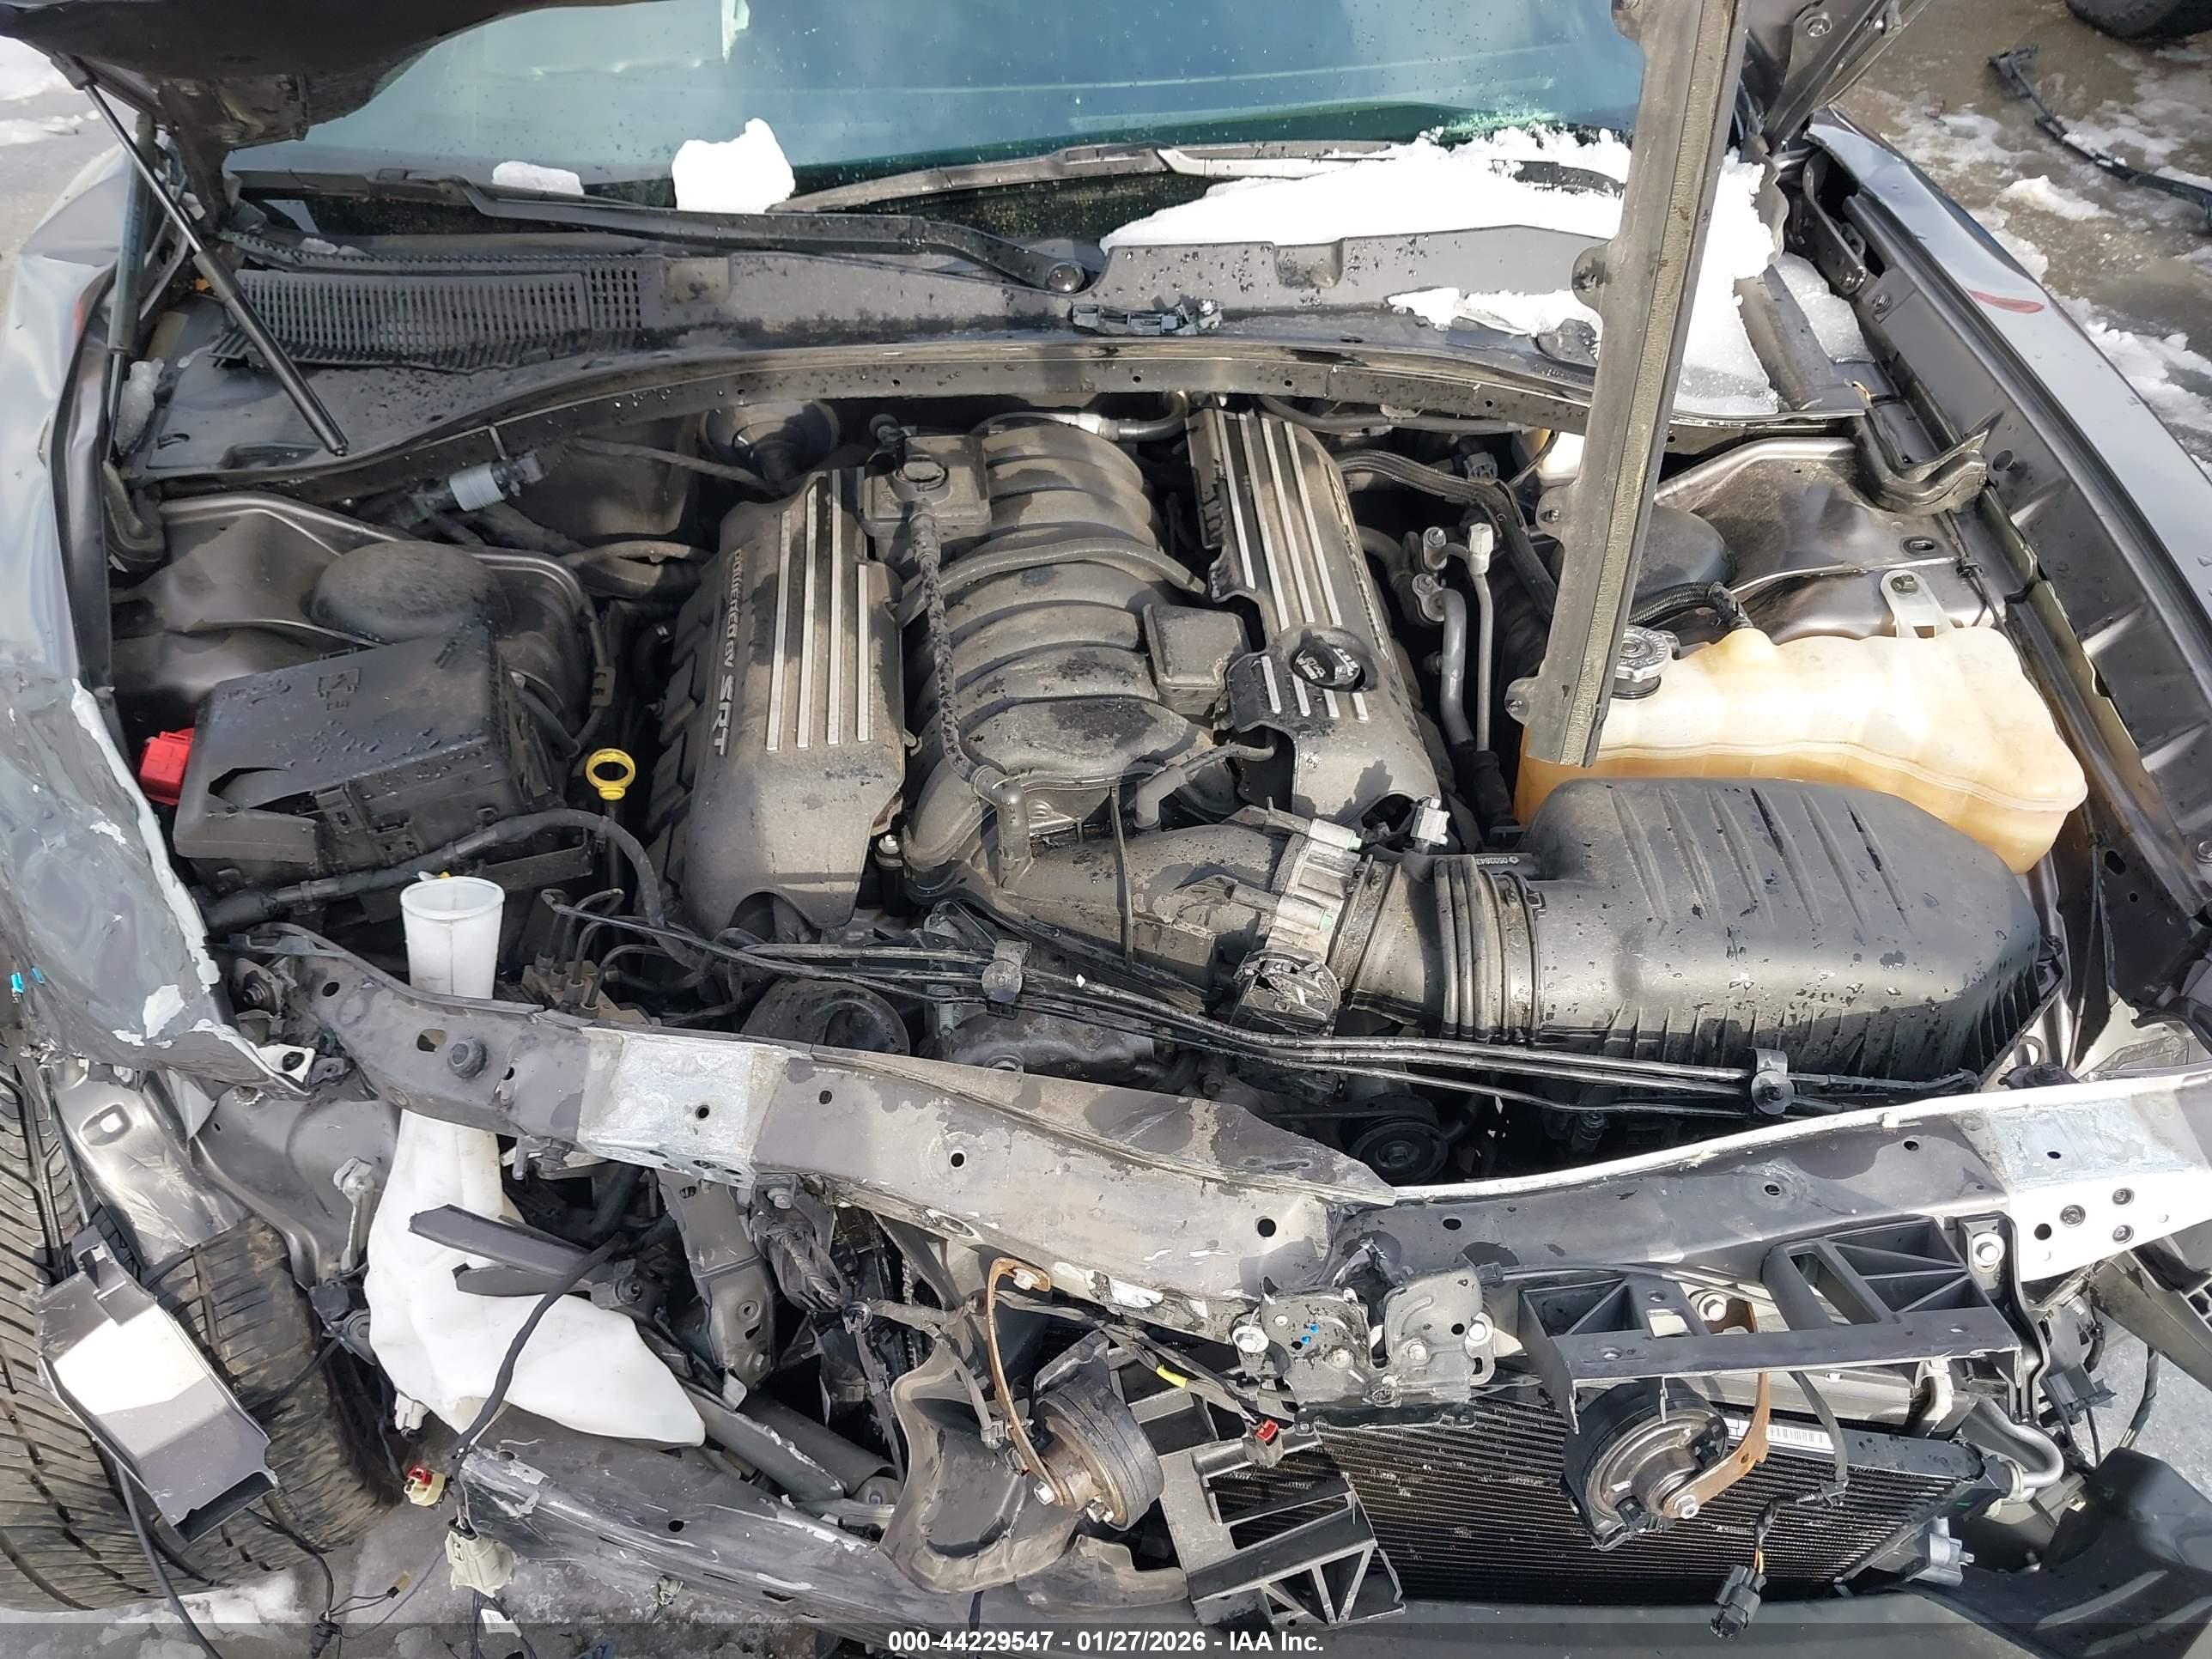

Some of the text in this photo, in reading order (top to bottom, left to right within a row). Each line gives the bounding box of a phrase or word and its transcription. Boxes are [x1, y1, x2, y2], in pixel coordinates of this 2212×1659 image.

[712, 549, 743, 756] POWERED BY SRT
